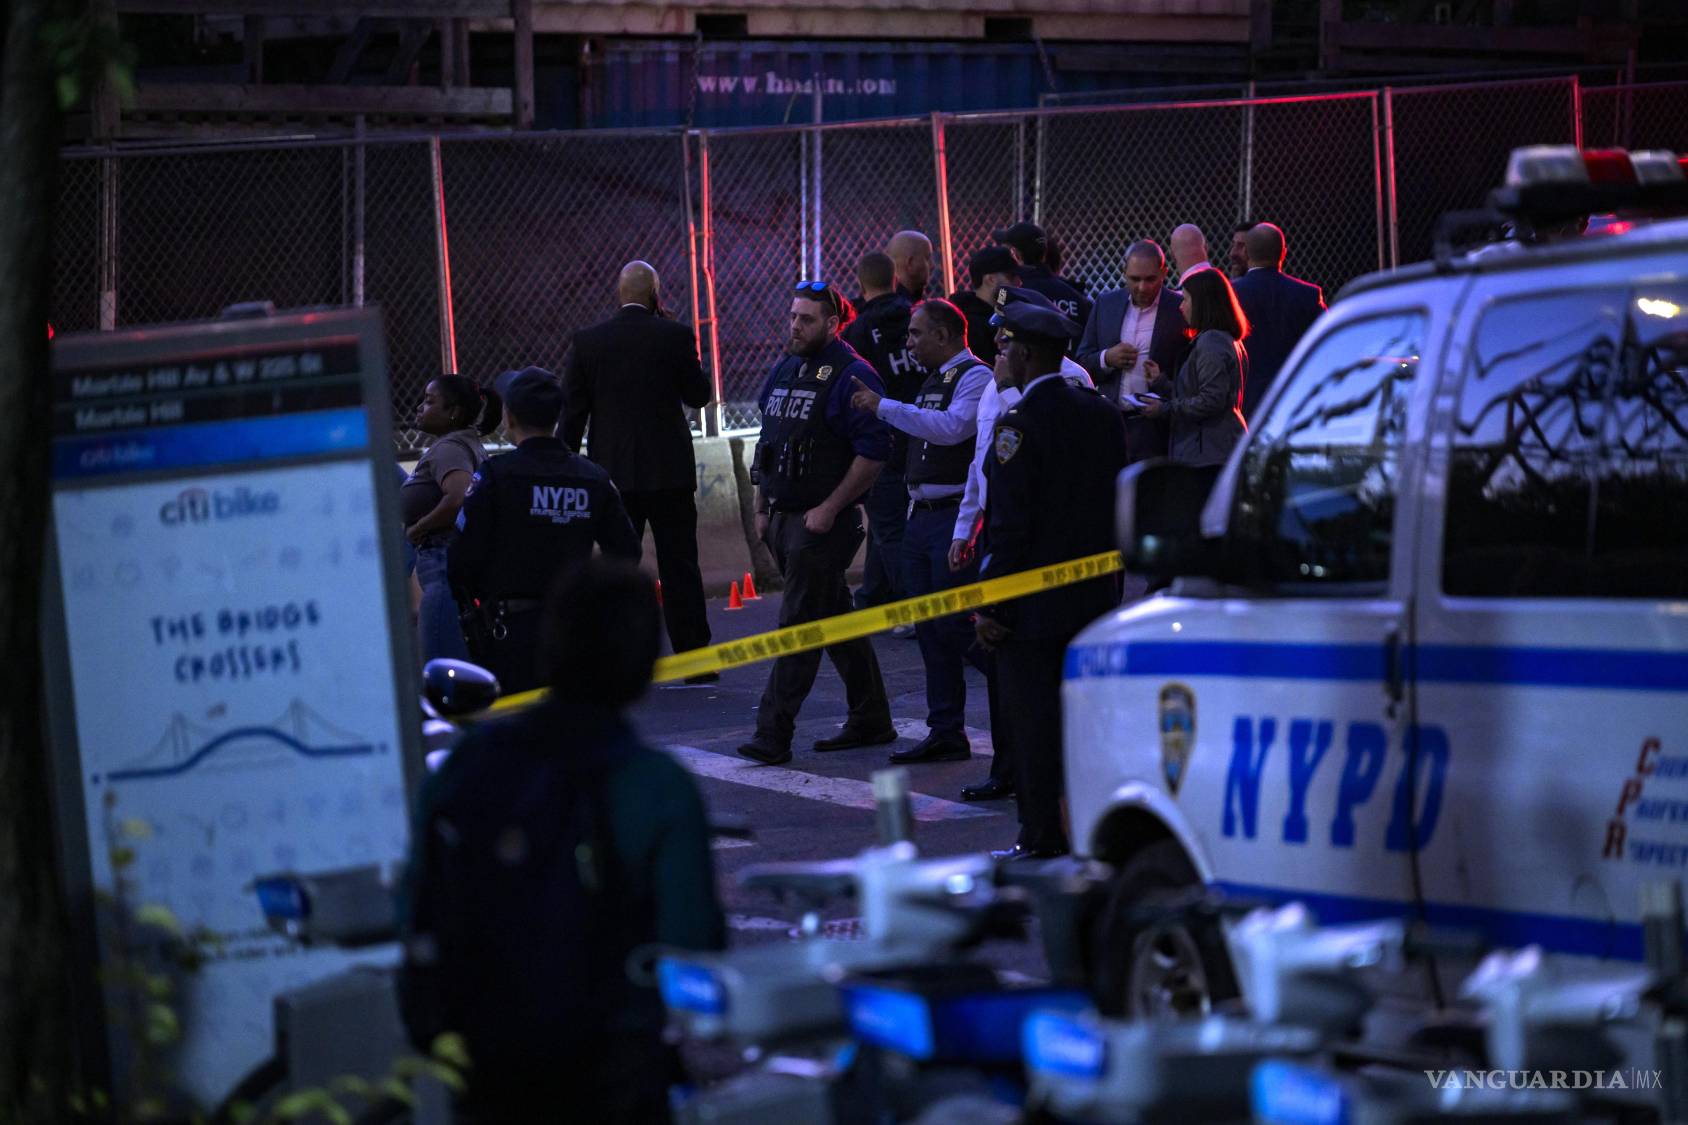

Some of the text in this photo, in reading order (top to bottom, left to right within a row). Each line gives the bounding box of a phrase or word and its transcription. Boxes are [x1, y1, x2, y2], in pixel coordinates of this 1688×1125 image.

[148, 366, 181, 388] Hill
[151, 400, 183, 421] Hill
[765, 396, 813, 420] POLICE
[533, 485, 589, 510] NYPD
[153, 600, 320, 645] THE BRIDGE
[1222, 716, 1451, 853] NYPD
